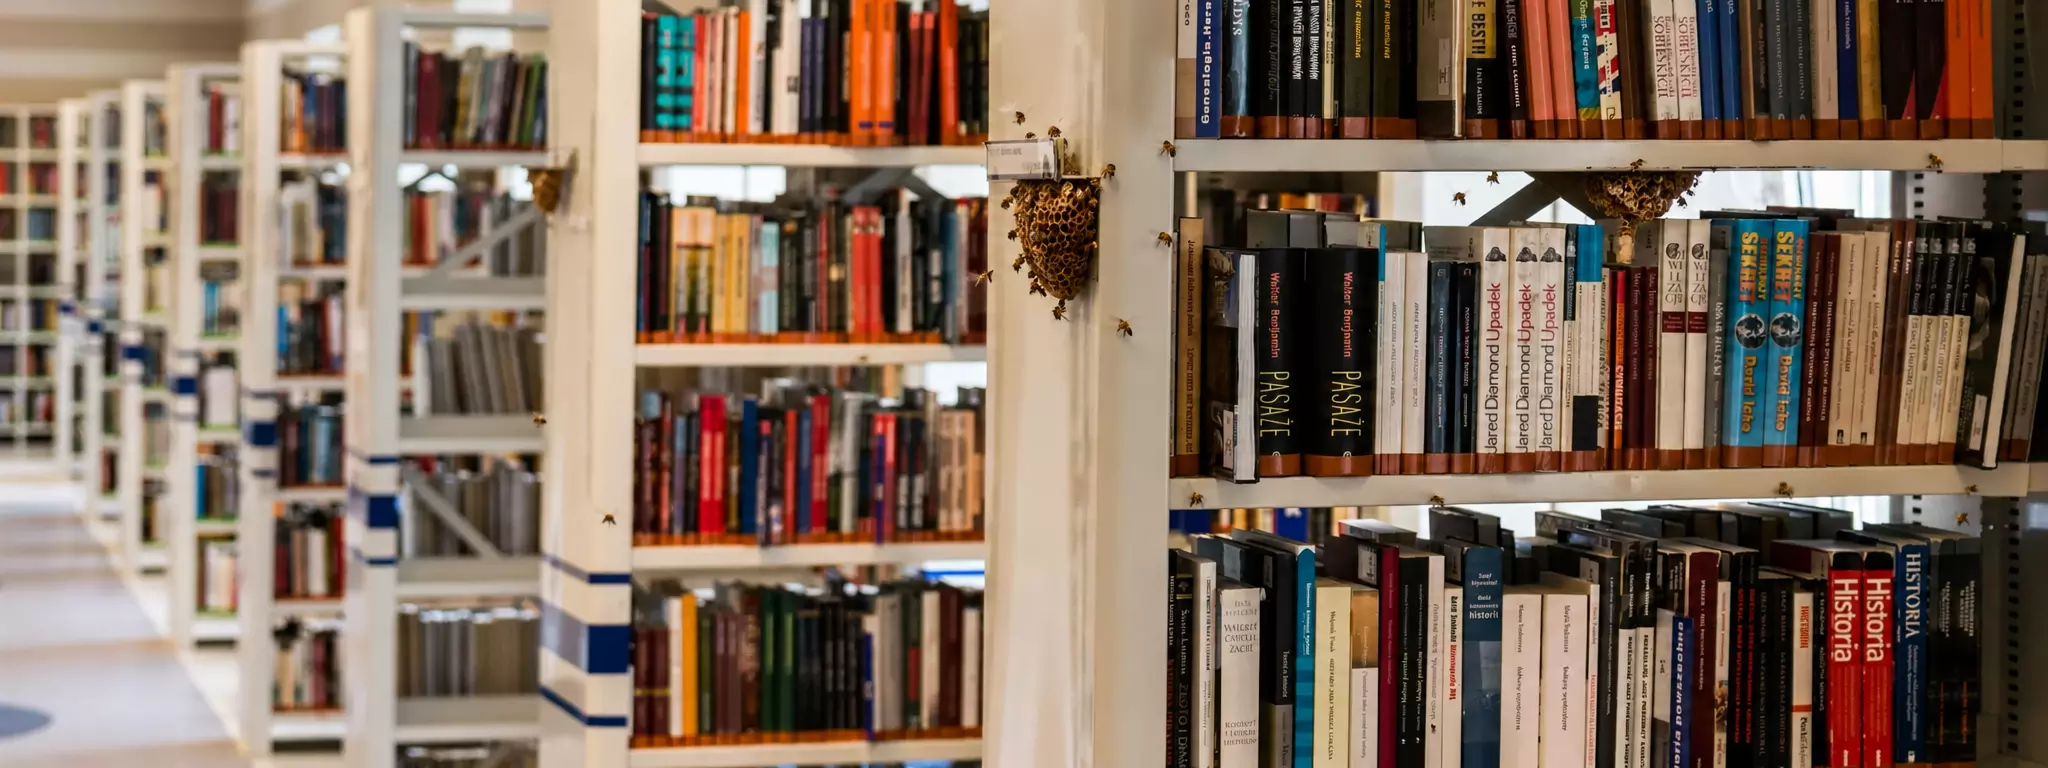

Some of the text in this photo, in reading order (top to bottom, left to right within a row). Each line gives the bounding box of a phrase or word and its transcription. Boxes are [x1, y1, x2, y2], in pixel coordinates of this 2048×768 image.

[1738, 231, 1759, 304] SEKRET
[1773, 231, 1795, 306] SEKRET
[1259, 371, 1291, 438] PASAŻE
[1331, 370, 1363, 437] PASAŻE
[1484, 283, 1503, 453] Jared Diamond Upadek
[1515, 283, 1534, 453] Jared Diamond Upadek
[1539, 283, 1558, 453] Jared Diamond Upadek
[1834, 578, 1858, 662] Historia
[1866, 578, 1891, 662] Historia
[1904, 552, 1921, 639] HISTORIA
